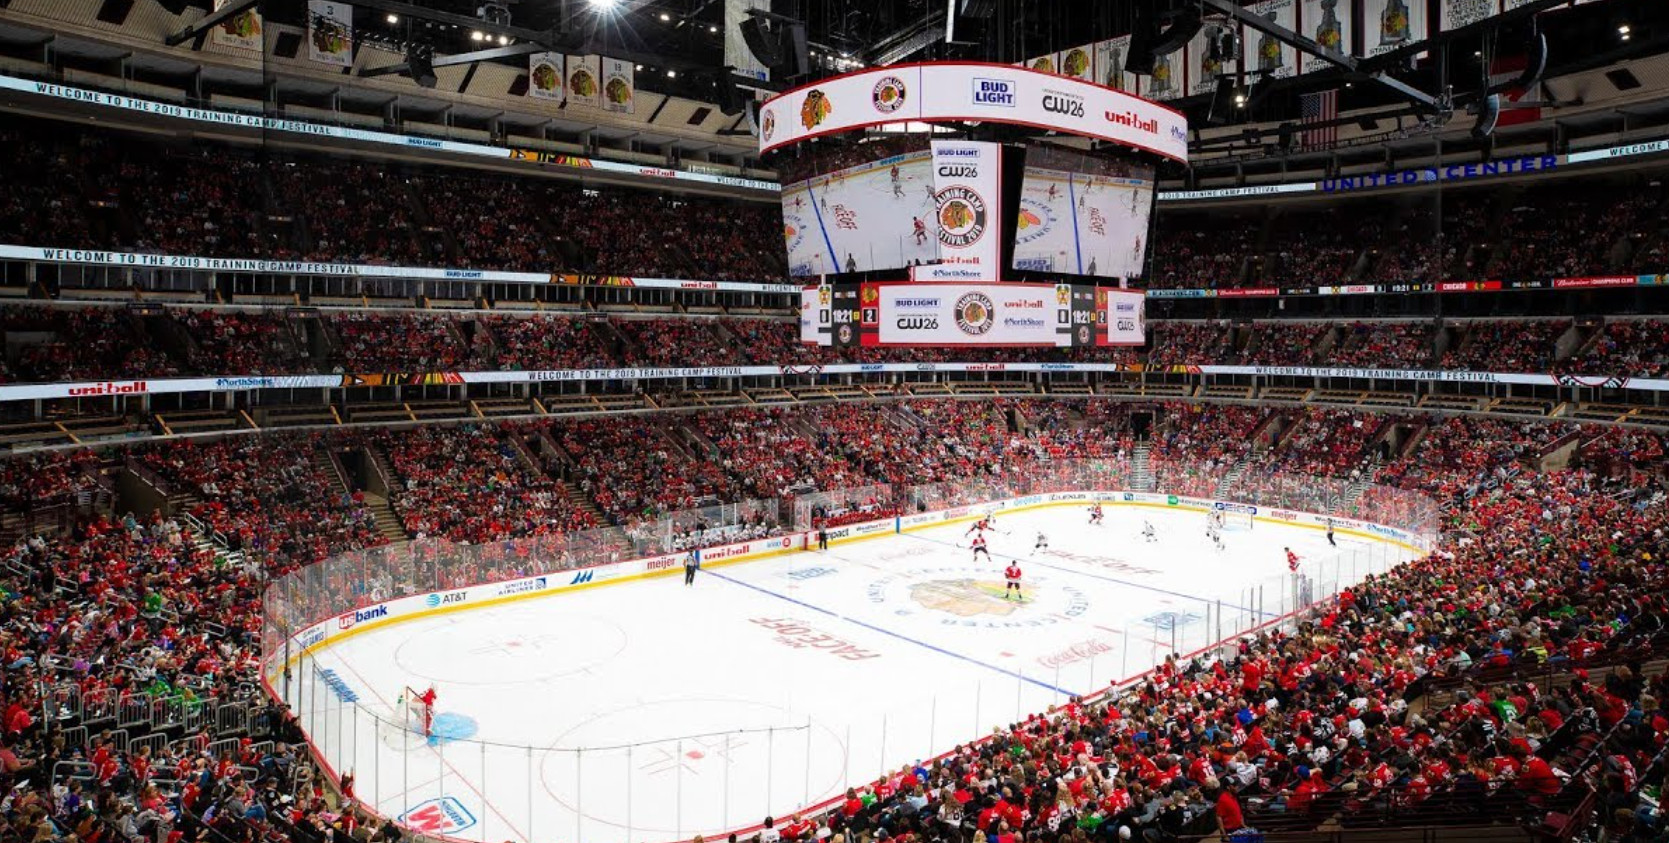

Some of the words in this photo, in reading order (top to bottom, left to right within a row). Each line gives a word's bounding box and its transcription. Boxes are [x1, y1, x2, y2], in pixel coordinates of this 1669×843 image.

[327, 6, 334, 15] 3
[981, 81, 1009, 93] BUD
[975, 92, 1013, 104] LIGHT
[36, 83, 101, 103] WELCOME
[106, 95, 122, 107] TO
[127, 98, 150, 111] THE
[154, 104, 182, 117] 2019
[186, 109, 242, 124] TRAINING
[247, 117, 278, 128] CAMP
[281, 120, 331, 136] FESTIVAL
[937, 148, 955, 156] BUD
[1610, 142, 1662, 156] WELCOME
[1323, 170, 1418, 191] UNITED
[1446, 154, 1558, 181] CENTER
[43, 249, 113, 263] WELCOME
[120, 254, 136, 264] TO
[142, 255, 166, 266] THE
[171, 256, 200, 268] 2019
[205, 258, 265, 271] TRAINING
[269, 261, 302, 272] CAMP
[307, 263, 361, 275] FESTIVAL
[446, 270, 461, 278] BUD
[461, 271, 482, 279] LIGHT
[866, 310, 873, 321] 2
[528, 370, 576, 380] WELCOME
[579, 370, 591, 379] TO
[594, 370, 612, 379] THE
[614, 369, 636, 378] 2019
[639, 368, 680, 378] TRAINING
[682, 368, 704, 377] CAMP
[706, 367, 743, 376] FESTIVAL
[1255, 366, 1298, 375] WELCOME
[1301, 367, 1313, 376] TO
[1315, 368, 1332, 376] THE
[1335, 368, 1358, 378] 2019
[1361, 369, 1409, 379] TRAINING
[1413, 370, 1442, 380] CAMP
[1446, 371, 1499, 383] FESTIVAL
[647, 556, 676, 570] meijer
[442, 591, 468, 604] AT&T
